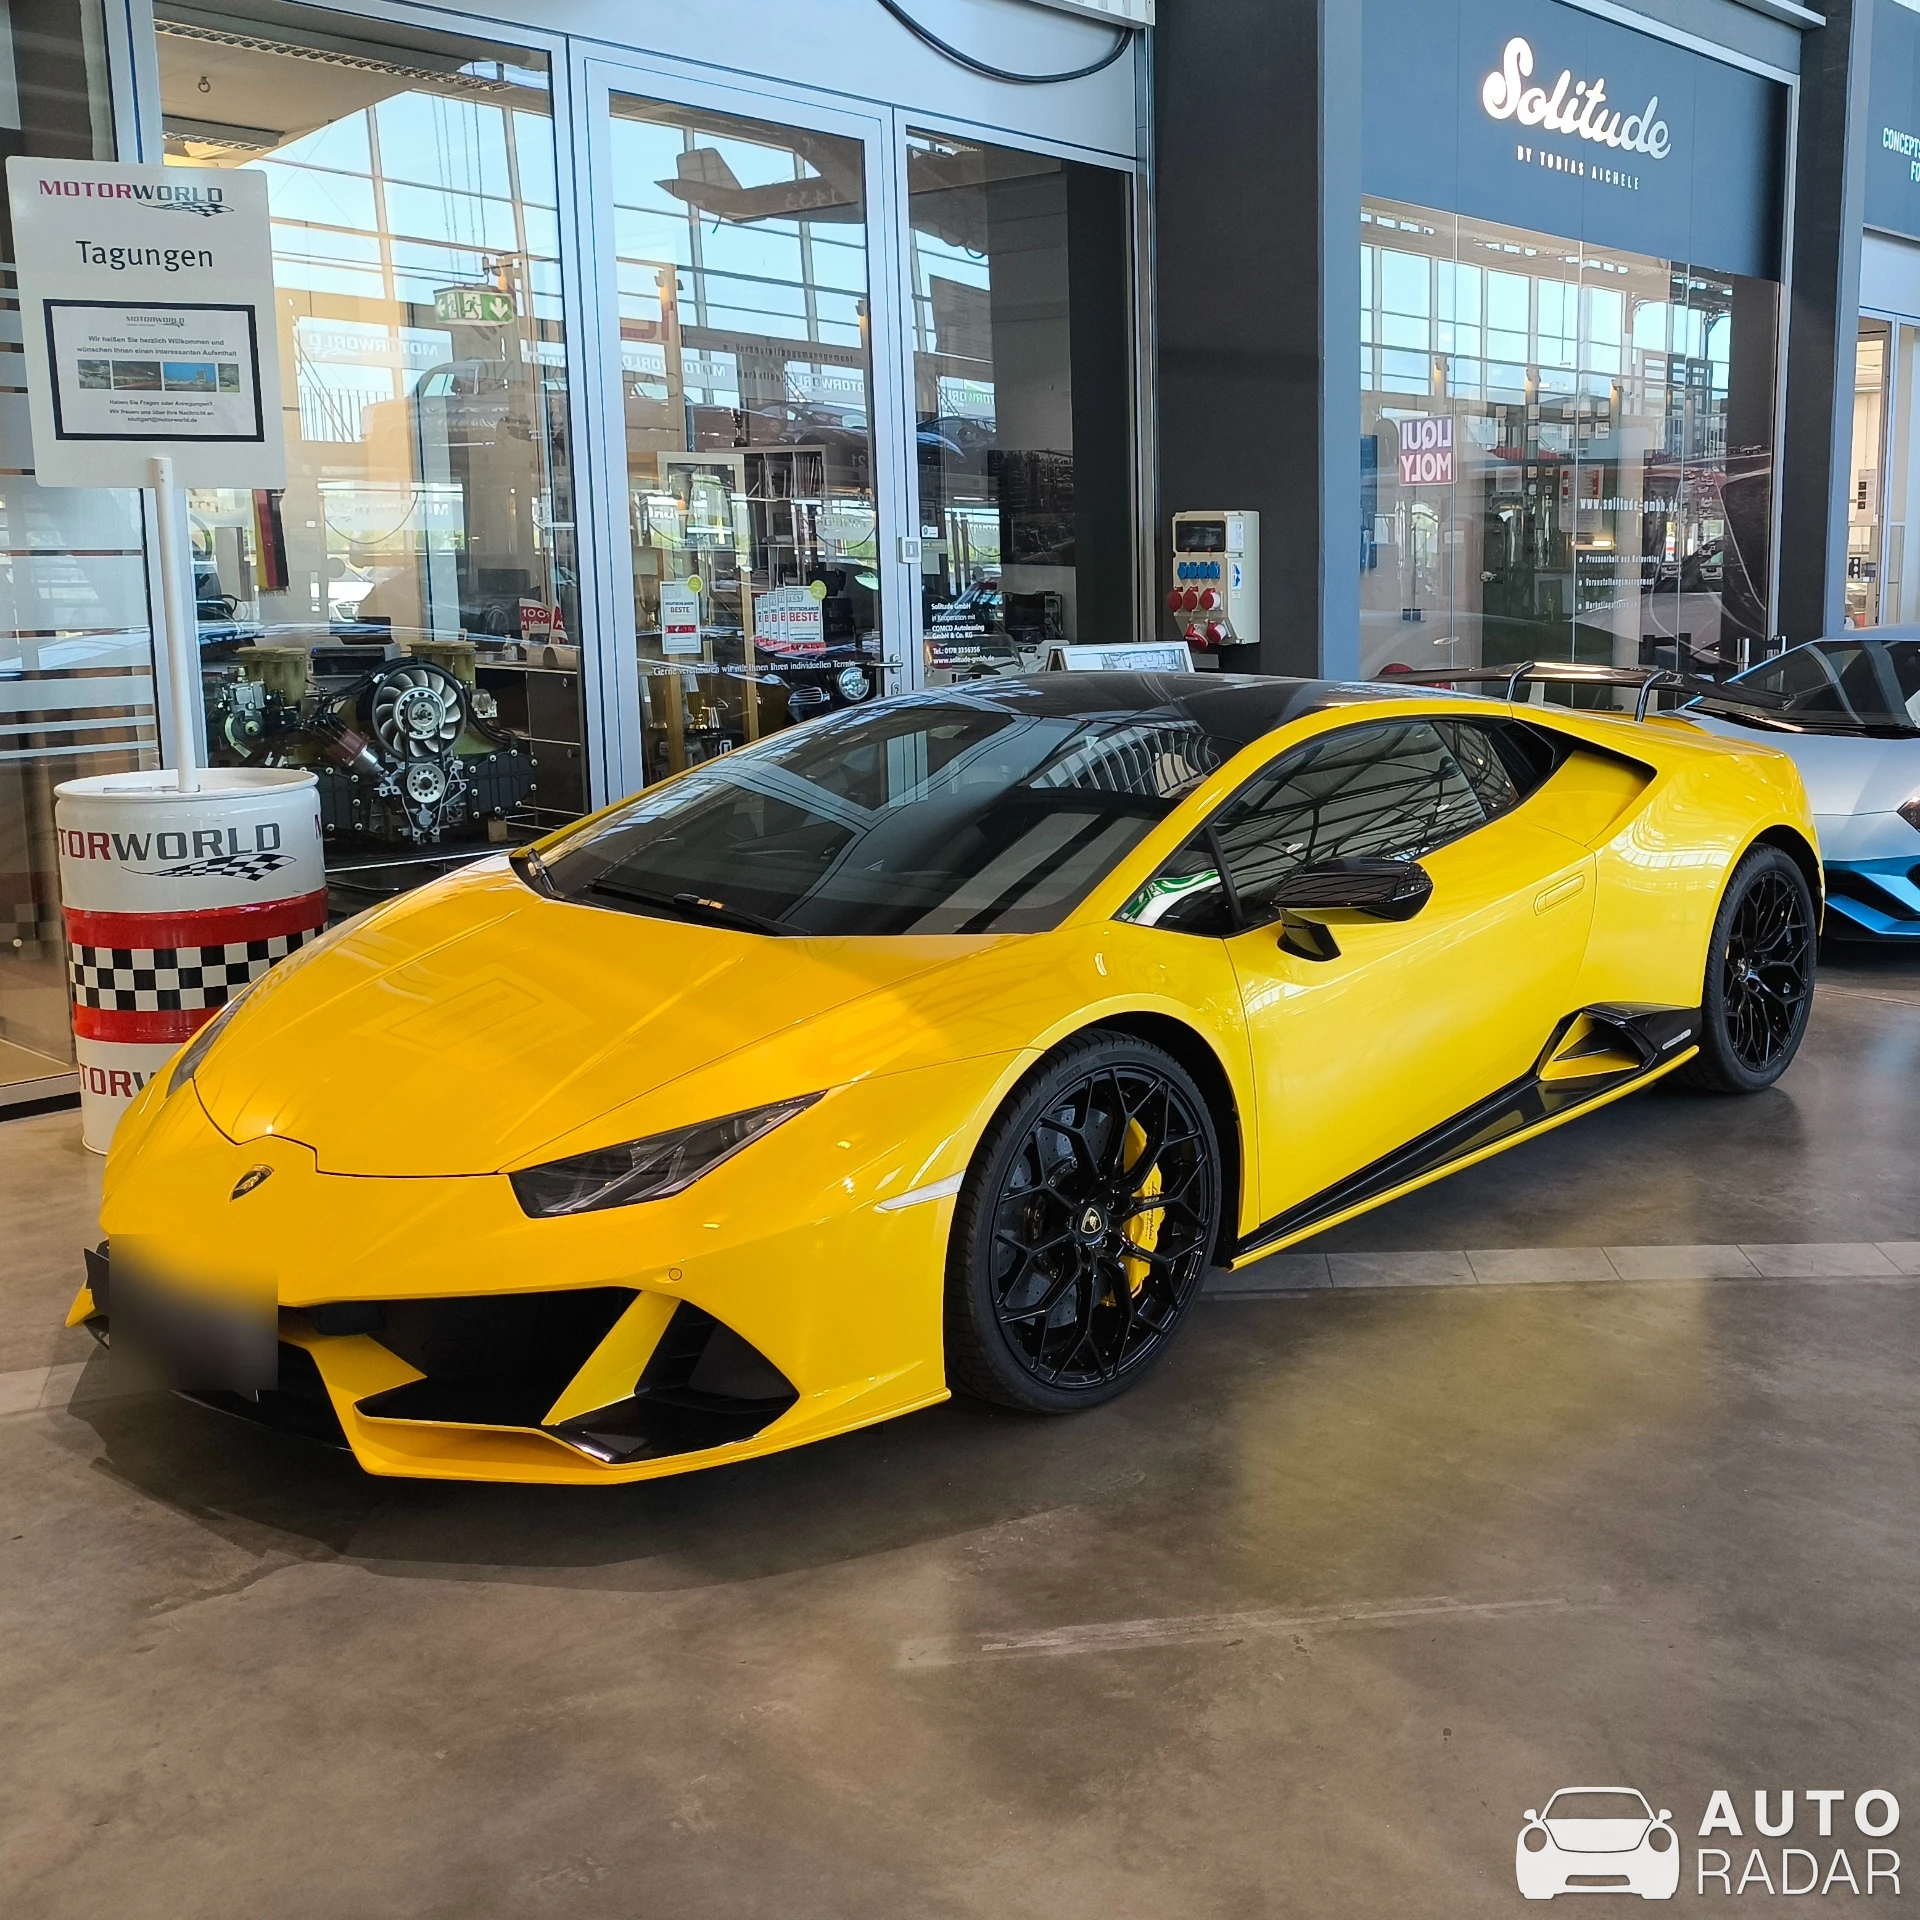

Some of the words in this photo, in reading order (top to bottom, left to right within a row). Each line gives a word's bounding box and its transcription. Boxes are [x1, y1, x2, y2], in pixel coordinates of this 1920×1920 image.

[1482, 36, 1672, 160] Solitude
[1516, 144, 1532, 163] BY
[1539, 150, 1585, 176] TOBIAS
[1591, 165, 1640, 191] AICHELE
[38, 179, 223, 203] MOTORWORLD
[75, 240, 214, 272] Tagungen
[126, 315, 185, 324] MOTORWORLD
[168, 338, 210, 346] Willkommen
[155, 348, 201, 356] interessanten
[202, 349, 237, 357] Aufenthalt
[1580, 497, 1678, 514] www.solitude-gmbh.de
[931, 602, 954, 610] Solitude
[954, 602, 971, 610] GmbH
[789, 611, 819, 622] BESTE
[932, 654, 995, 664] www.solitude-gmbh.de
[653, 666, 677, 676] Gerne
[770, 662, 789, 671] Ihren
[790, 660, 832, 670] individuellen
